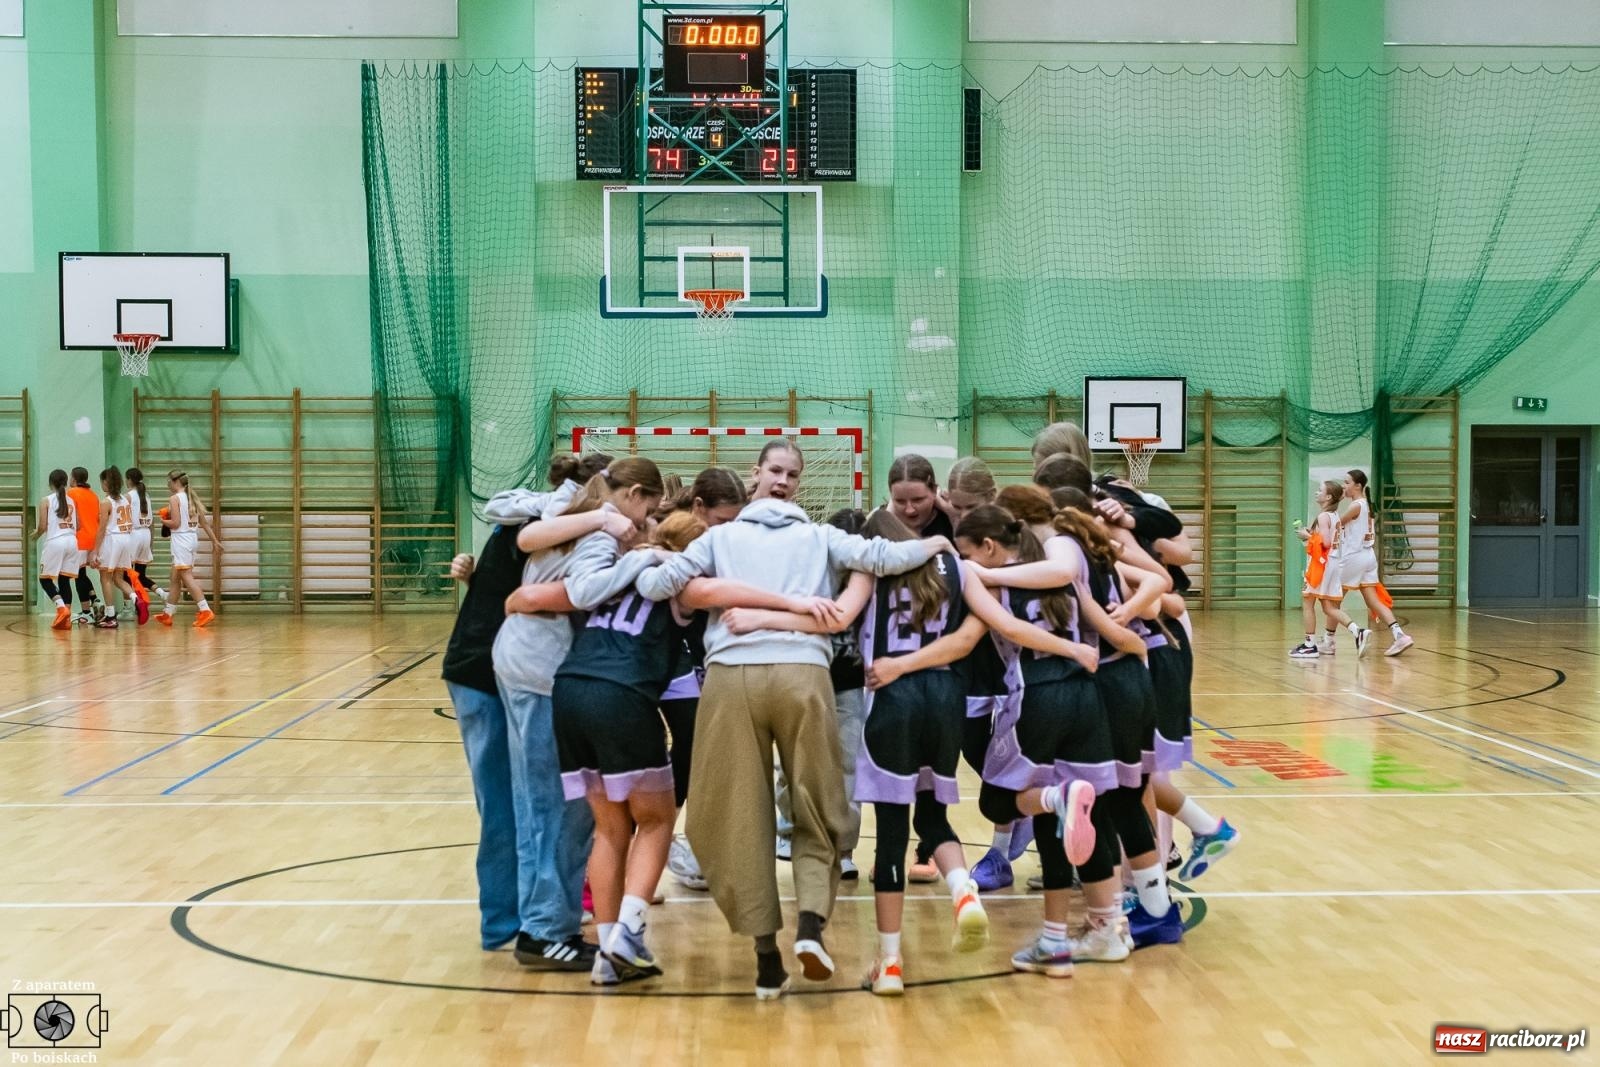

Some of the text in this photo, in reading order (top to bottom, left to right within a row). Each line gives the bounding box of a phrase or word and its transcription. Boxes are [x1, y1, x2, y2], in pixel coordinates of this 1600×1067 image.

[740, 85, 752, 93] 3D
[712, 134, 722, 147] 4
[649, 148, 681, 170] 74
